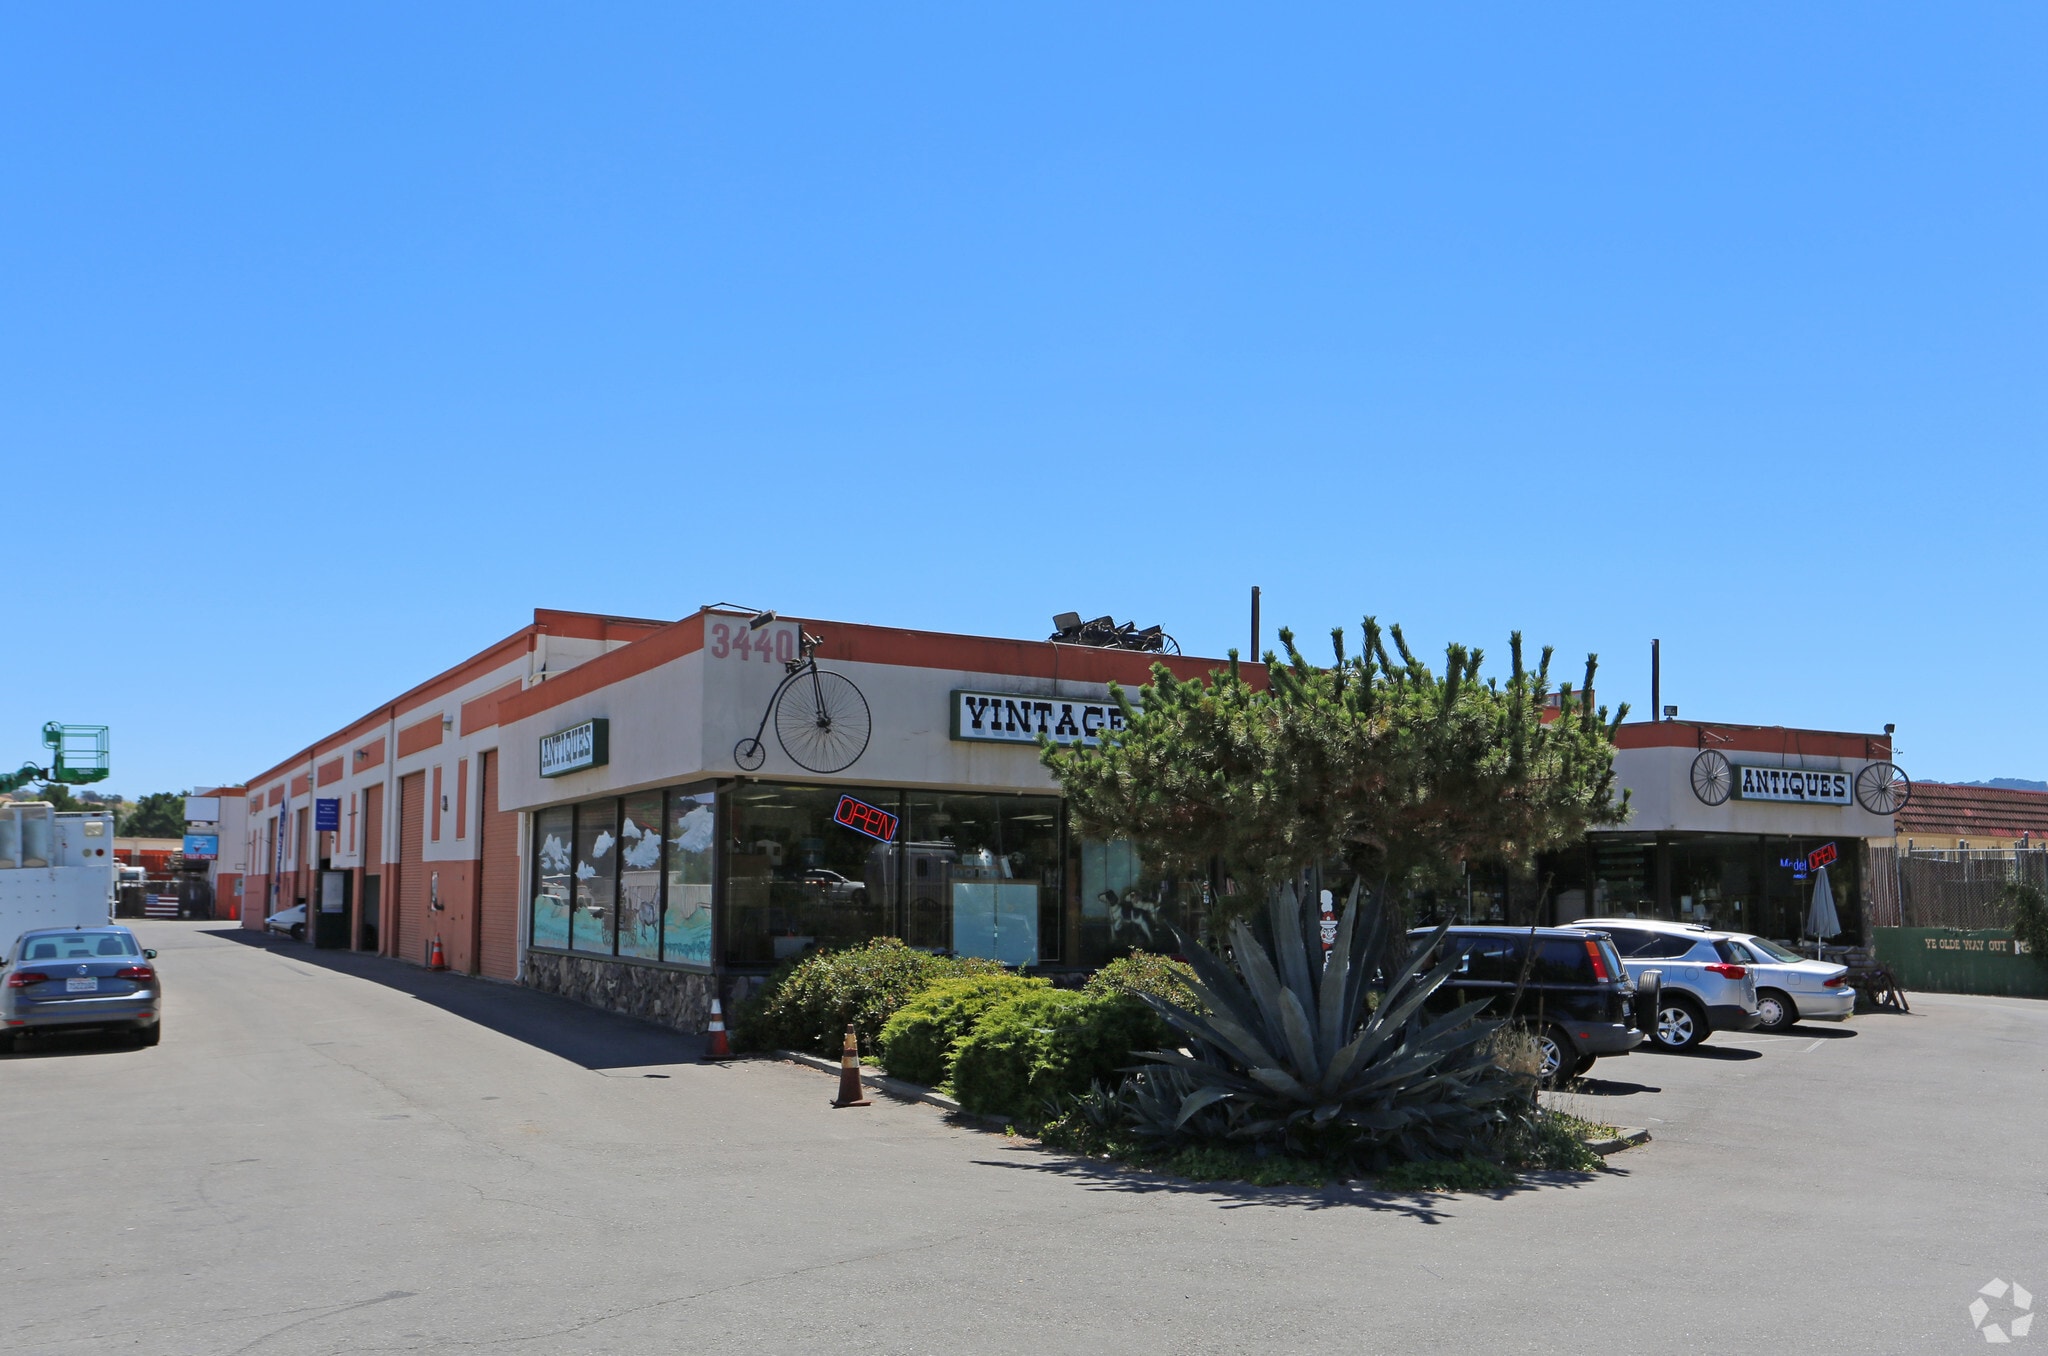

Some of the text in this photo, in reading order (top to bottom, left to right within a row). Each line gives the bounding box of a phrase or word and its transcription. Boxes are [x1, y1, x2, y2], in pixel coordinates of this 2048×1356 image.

[711, 623, 793, 664] 3440
[965, 696, 1128, 737] VINTAGE
[542, 725, 591, 768] ANTIQUES
[1743, 769, 1846, 799] ANTIQUES
[837, 798, 897, 840] OPEN
[1809, 845, 1837, 869] OPEN
[1925, 938, 1937, 949] YE
[1940, 939, 1960, 950] OLDE
[1963, 940, 1985, 951] WAY
[1989, 940, 2007, 951] OUT
